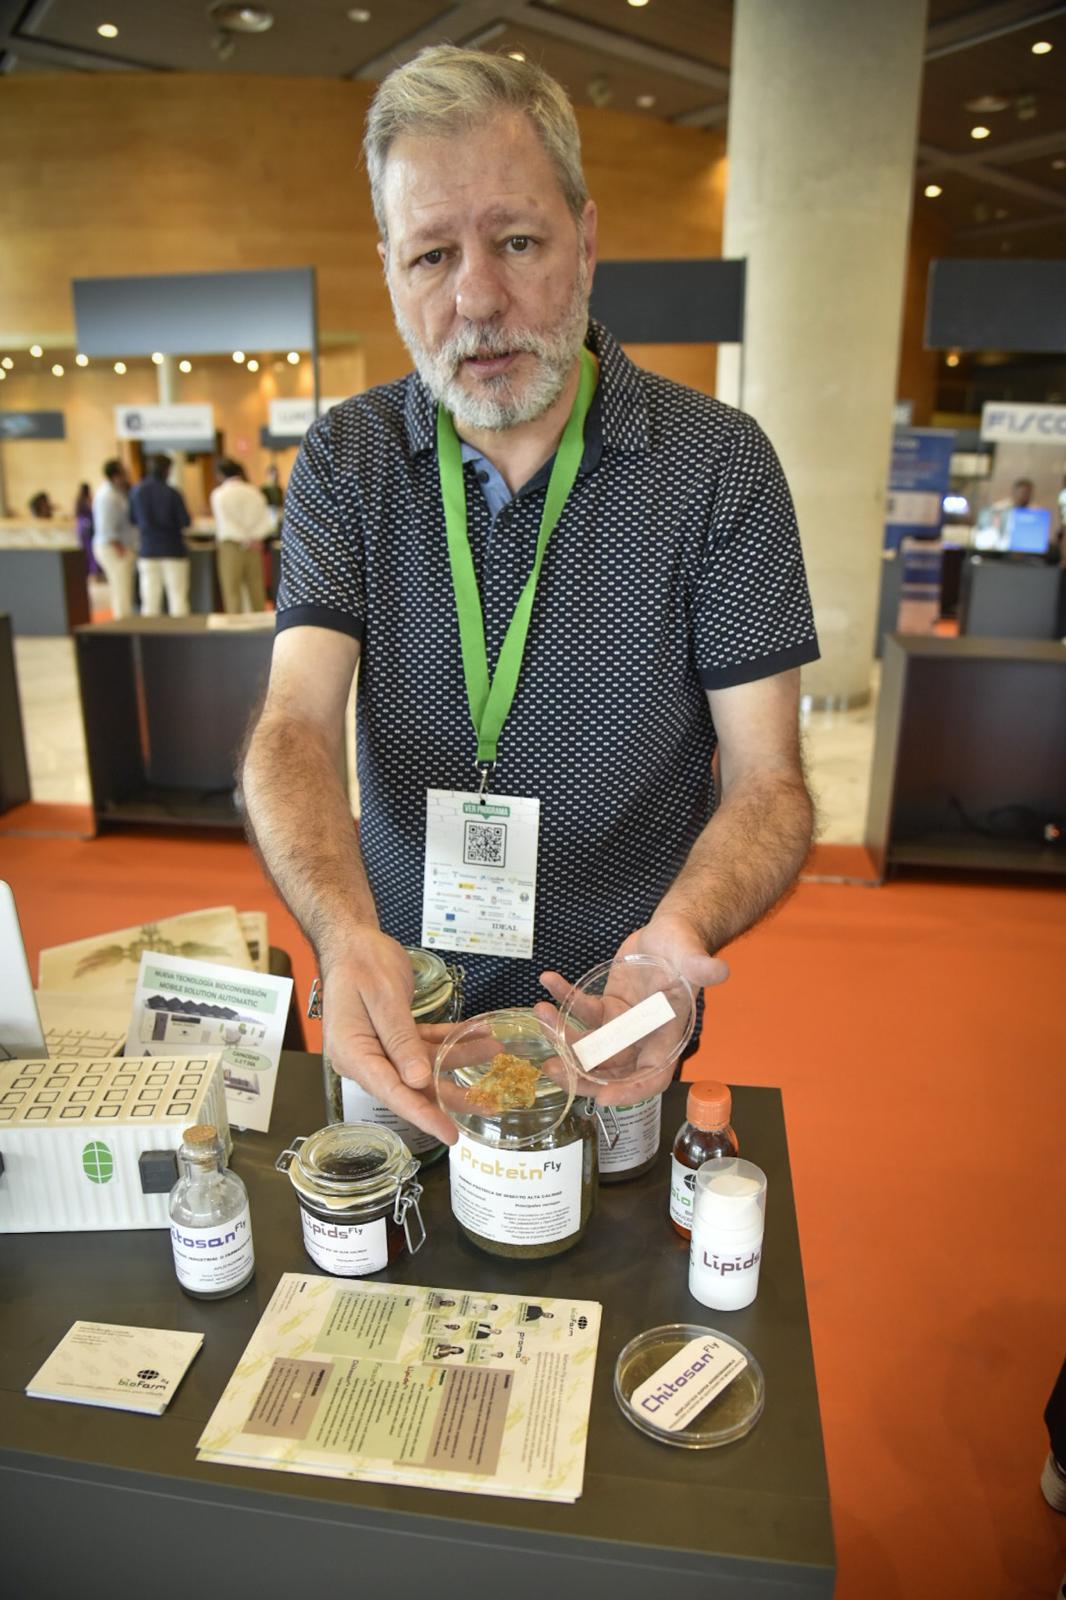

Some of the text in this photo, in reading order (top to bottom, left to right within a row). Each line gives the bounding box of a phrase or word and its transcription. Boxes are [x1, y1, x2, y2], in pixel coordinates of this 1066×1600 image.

[492, 923, 518, 931] IDEAL
[155, 970, 175, 979] NUEVA
[159, 982, 259, 1008] MOBILE SOLUTION AUTOMATIC
[460, 1146, 561, 1180] Protein Fly
[304, 1212, 349, 1240] Lipids
[516, 1331, 524, 1359] proma
[118, 1378, 166, 1391] bioFarm
[641, 1352, 714, 1413] Chitosan
[703, 1342, 720, 1353] Fly
